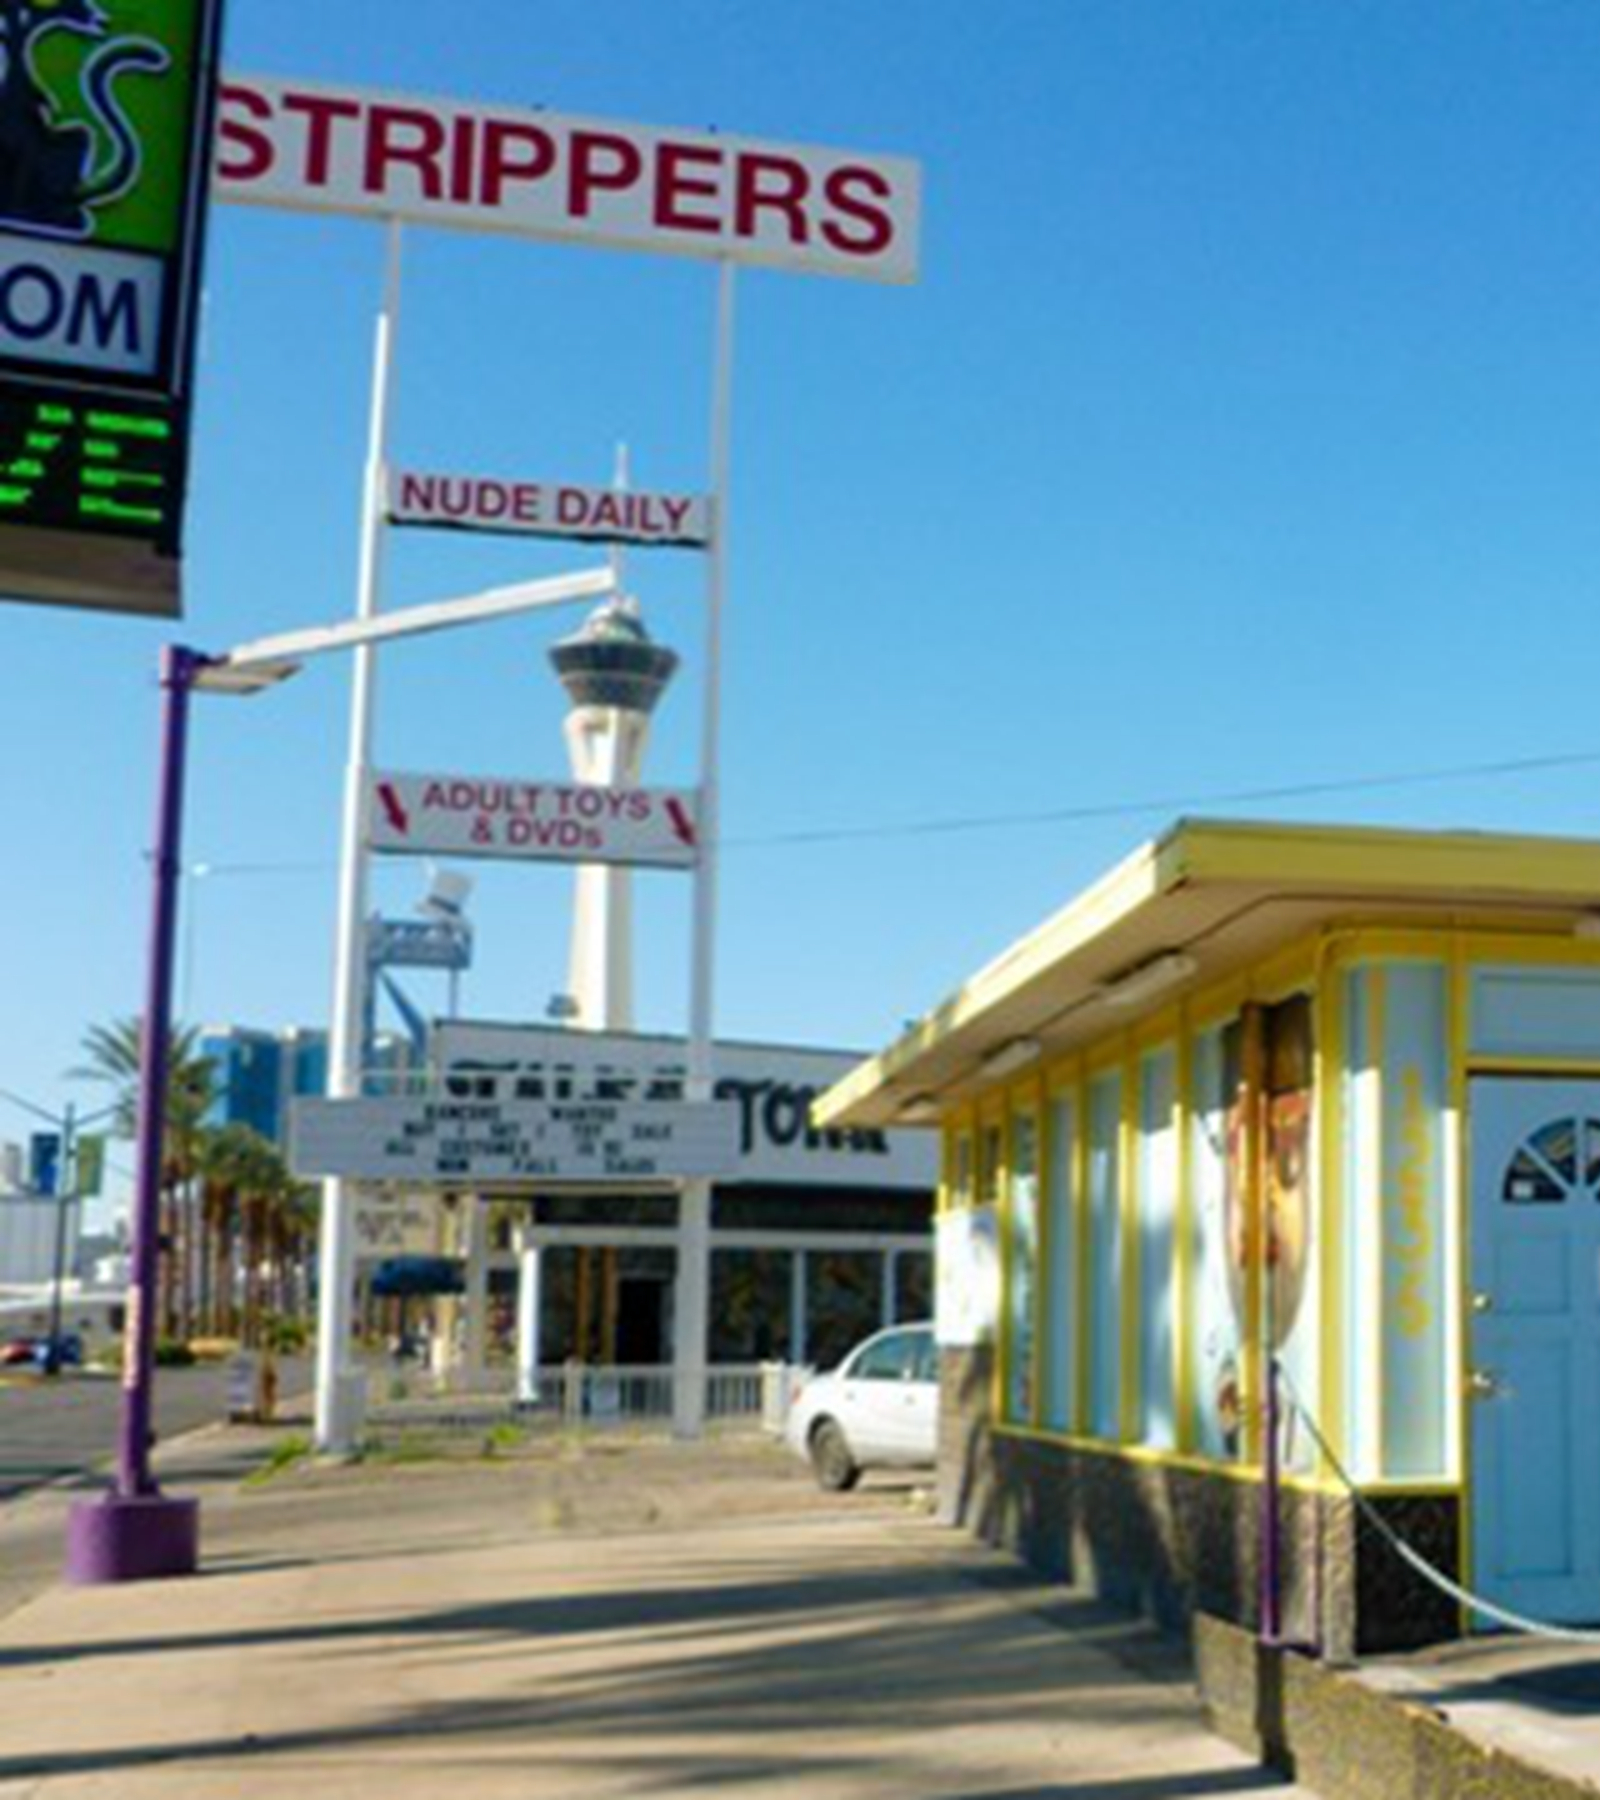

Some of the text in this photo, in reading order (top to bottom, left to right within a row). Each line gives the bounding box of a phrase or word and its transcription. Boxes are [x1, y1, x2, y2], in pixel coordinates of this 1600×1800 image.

[211, 84, 896, 256] STRIPPERS
[401, 474, 692, 534] NUDE DAILY
[423, 781, 652, 821] ADULT TOYS
[470, 813, 493, 845] &
